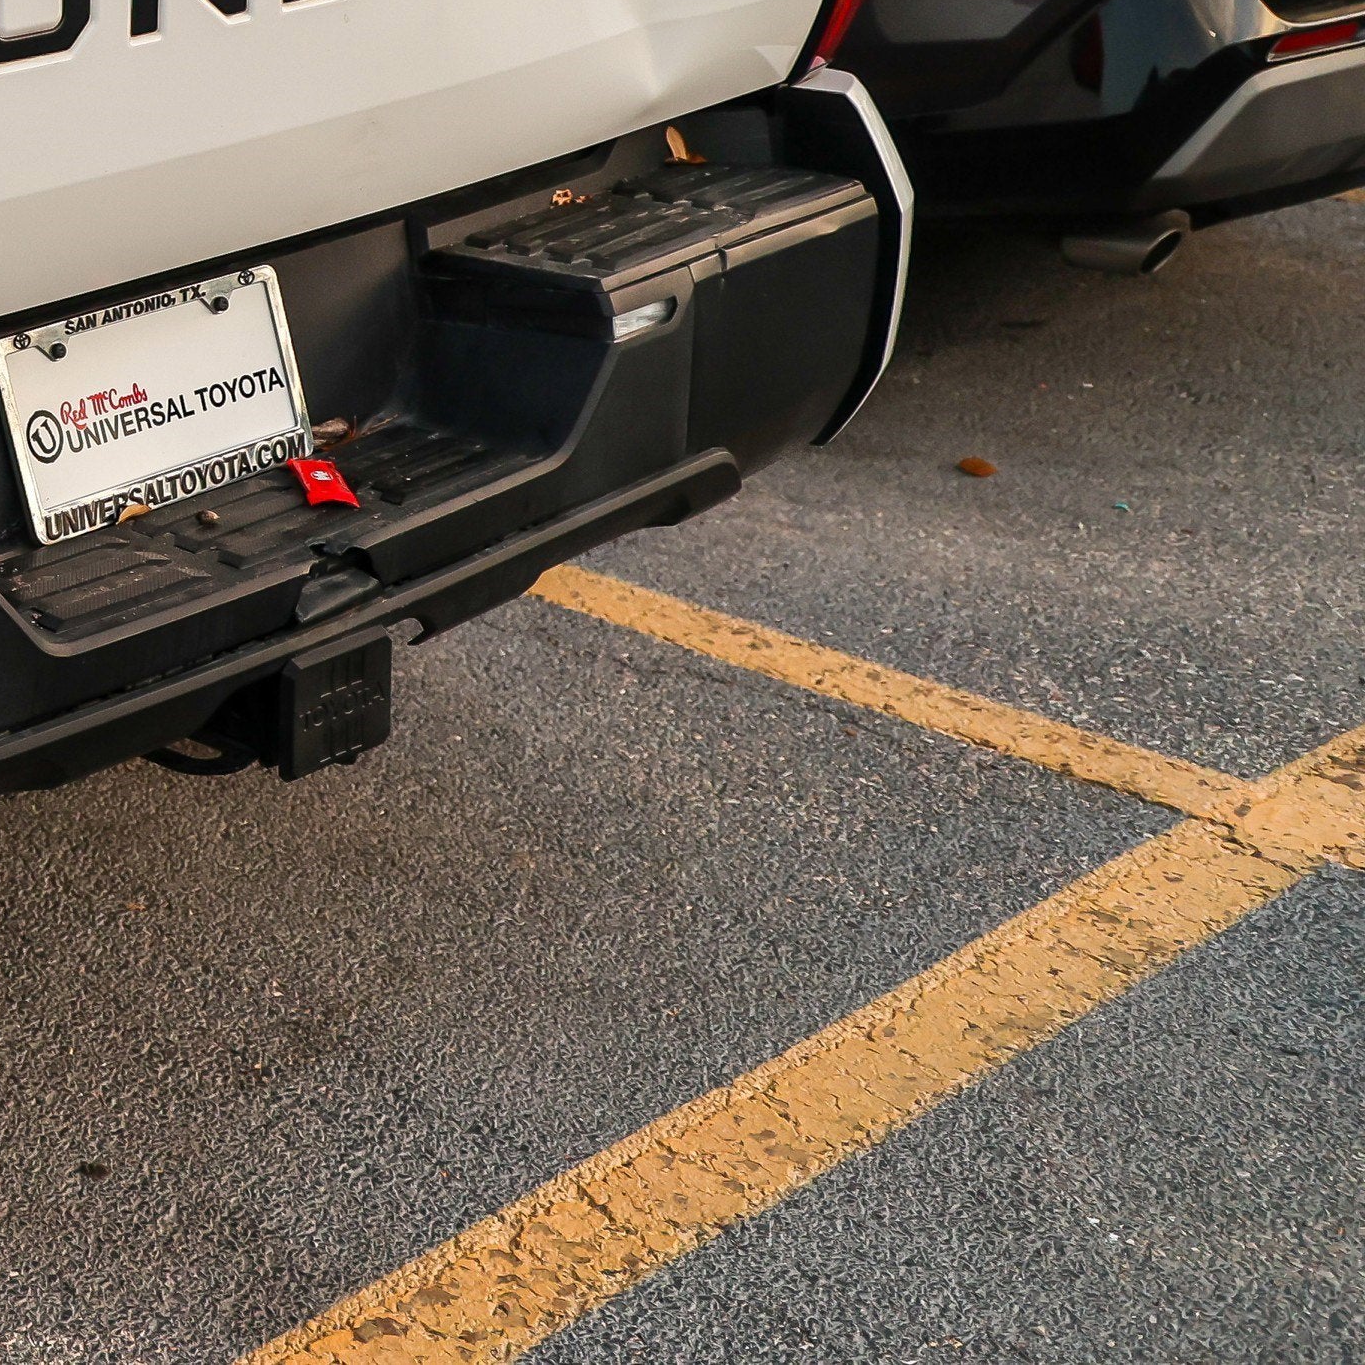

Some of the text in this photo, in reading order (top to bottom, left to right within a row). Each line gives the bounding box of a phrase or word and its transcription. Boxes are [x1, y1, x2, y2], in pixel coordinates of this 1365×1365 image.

[64, 284, 207, 335] SAN ANTONIO, TX.
[60, 382, 148, 430] Red McCombs
[66, 366, 285, 454] UNIVERSAL TOYOTA
[44, 431, 306, 541] UNIVERSALTOYOTA.COM
